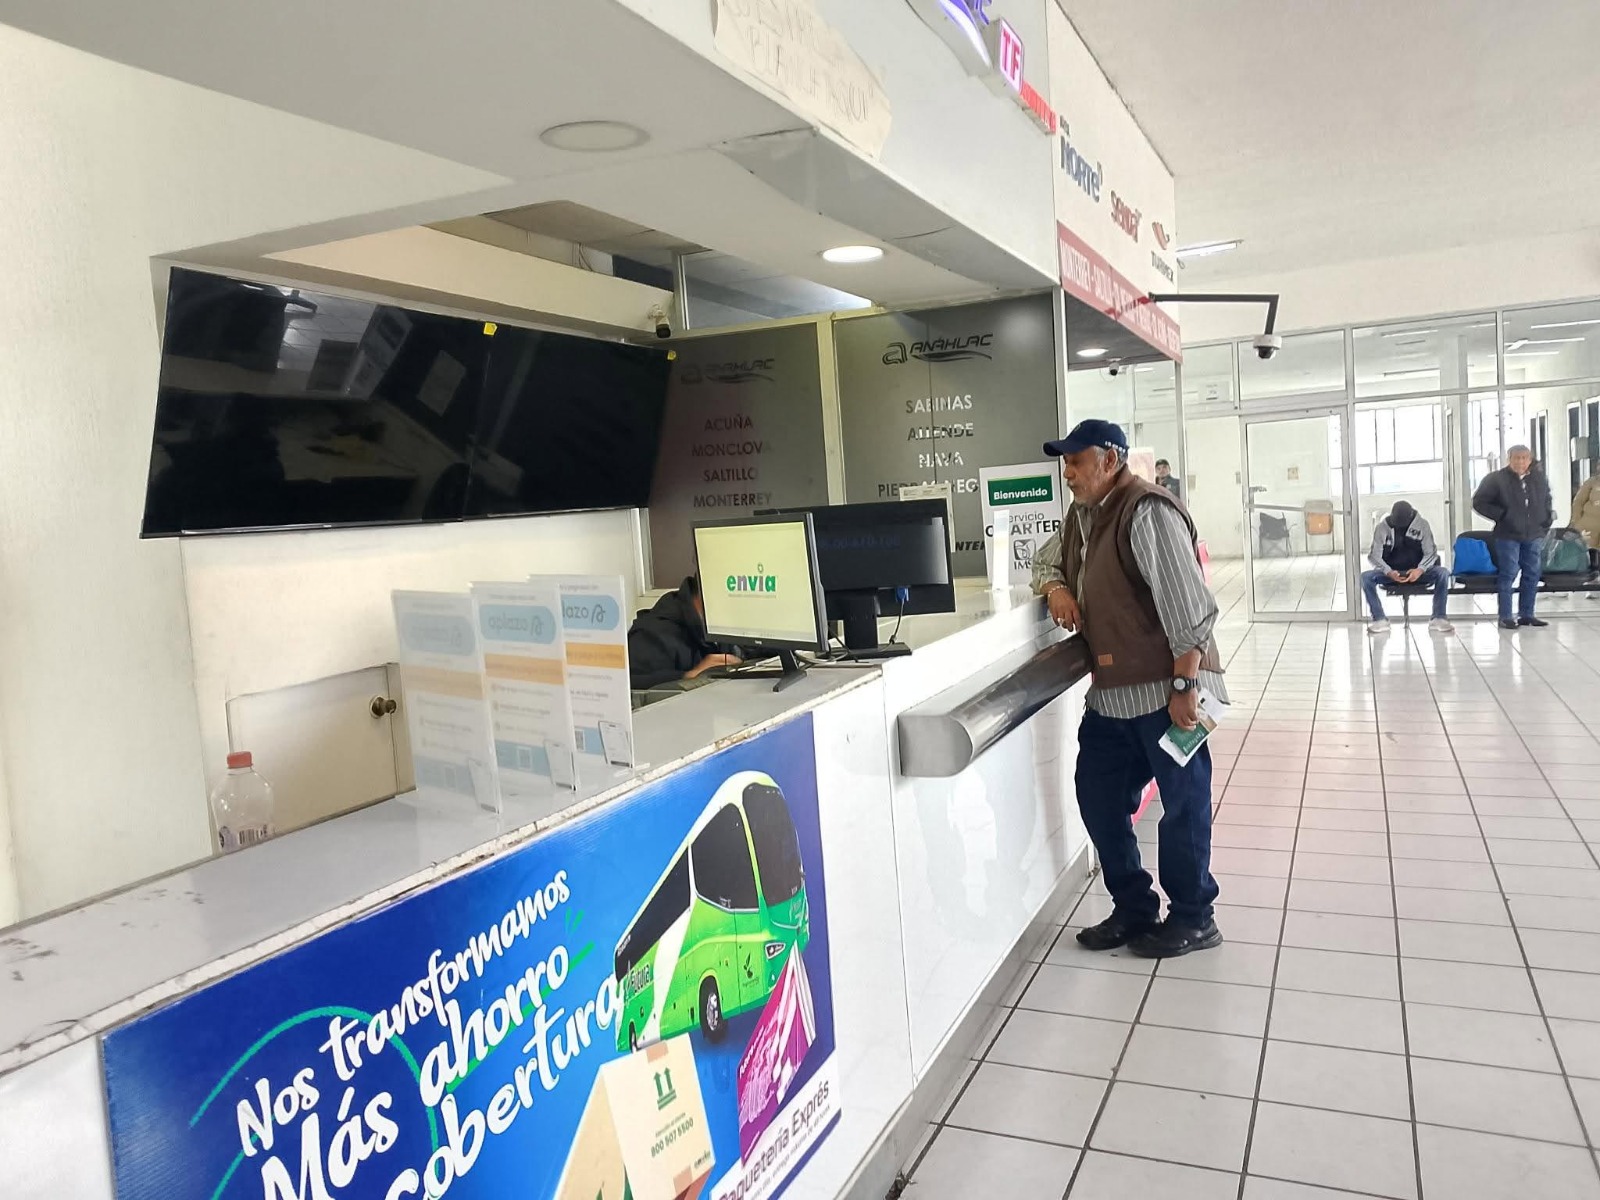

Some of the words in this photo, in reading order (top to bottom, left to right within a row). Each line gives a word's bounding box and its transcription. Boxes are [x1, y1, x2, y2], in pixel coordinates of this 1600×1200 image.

[905, 394, 974, 414] SABINAS
[704, 413, 754, 432] ACUÑA
[907, 422, 974, 441] ALLENDE
[918, 451, 964, 469] NAVA
[693, 491, 772, 507] MONTERREY
[993, 487, 1048, 501] Bienvenido
[1009, 510, 1045, 523] ervicio
[985, 519, 1061, 538] CARTER
[236, 1067, 320, 1157] Nos
[318, 869, 571, 1081] transformamos
[260, 1086, 399, 1200] Más
[419, 944, 570, 1108] ahorro
[792, 1079, 829, 1137] Exprés
